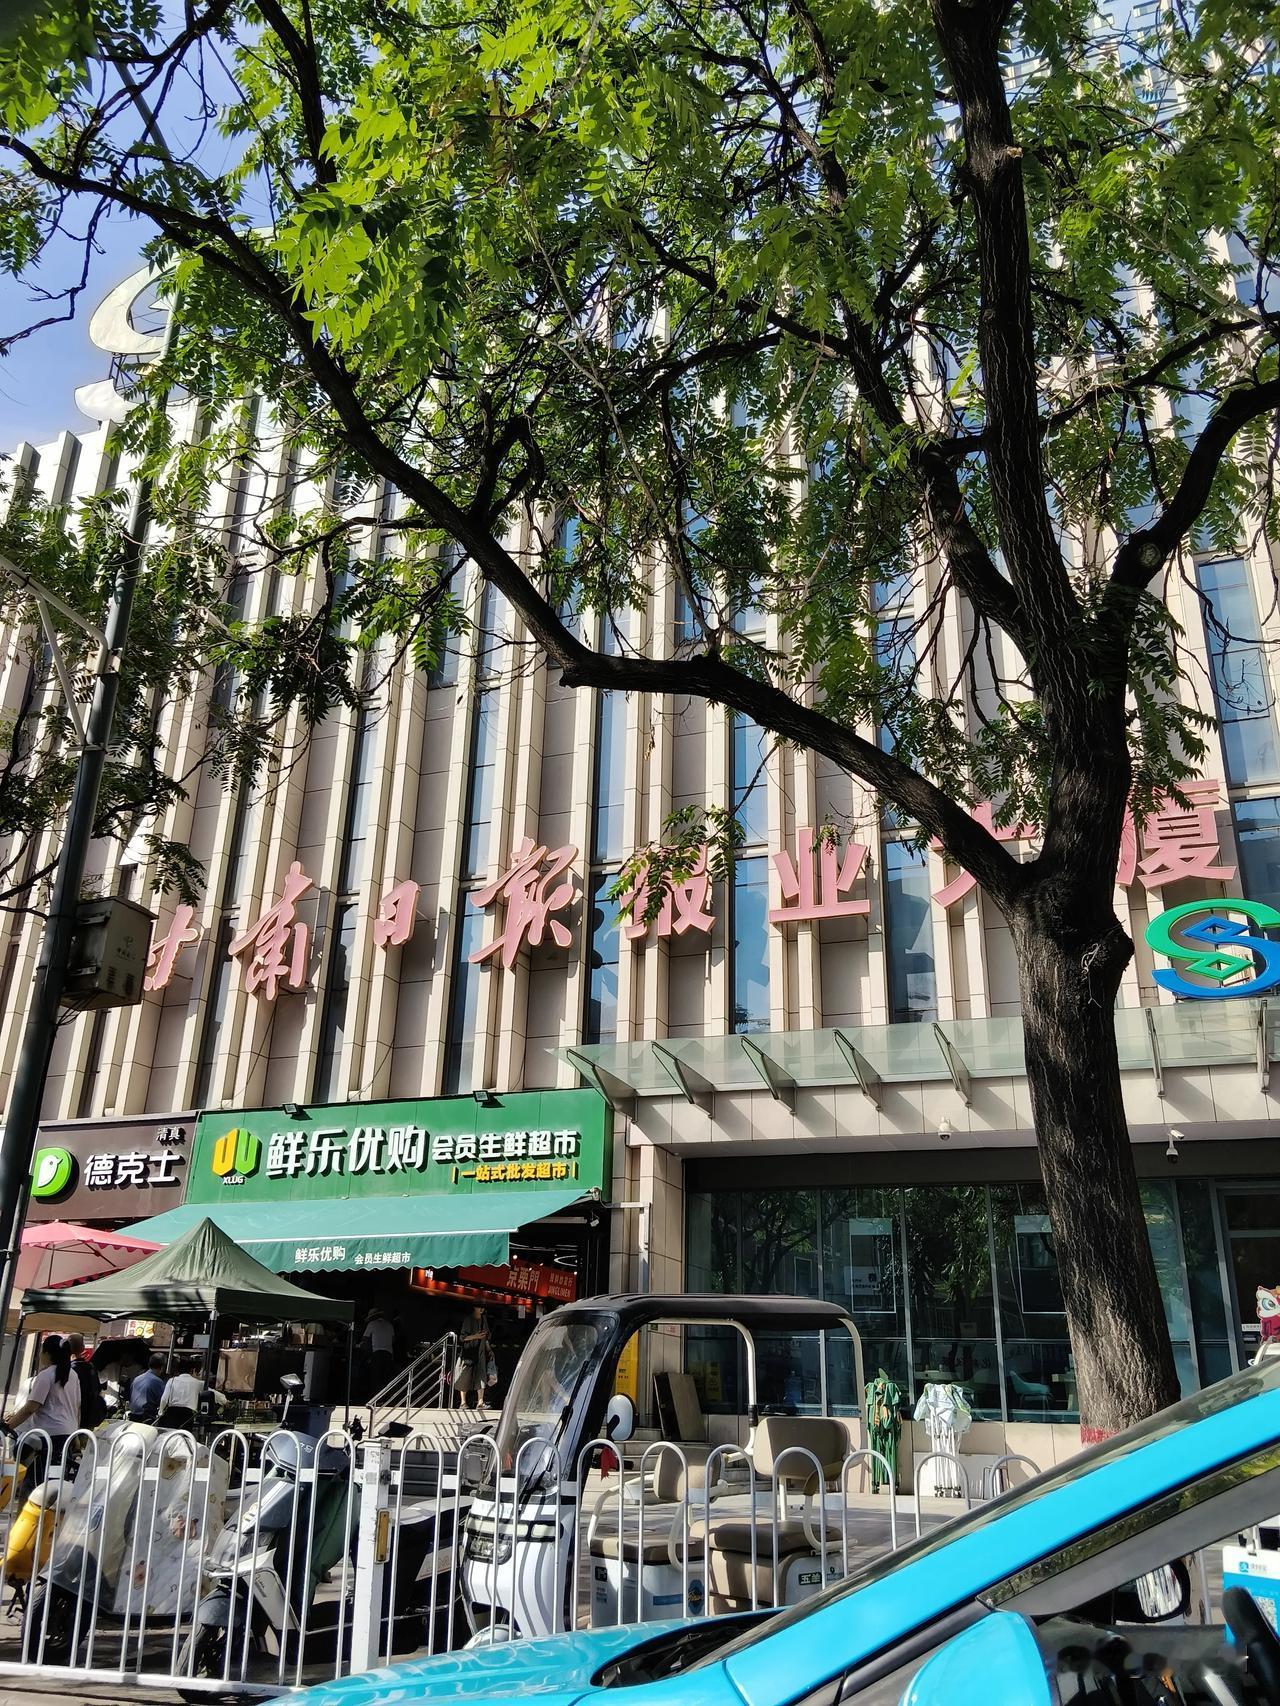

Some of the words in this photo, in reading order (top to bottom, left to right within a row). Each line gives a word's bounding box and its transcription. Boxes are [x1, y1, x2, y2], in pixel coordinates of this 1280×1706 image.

[156, 1126, 181, 1141] 清真
[266, 1124, 426, 1177] 鲜乐优购
[431, 1129, 577, 1161] 会员生鲜超市
[84, 1150, 180, 1186] 德克士
[460, 1161, 567, 1182] 一站式批发超市
[294, 1245, 346, 1264] 鲜乐优购
[354, 1252, 411, 1265] 会员生鲜超市
